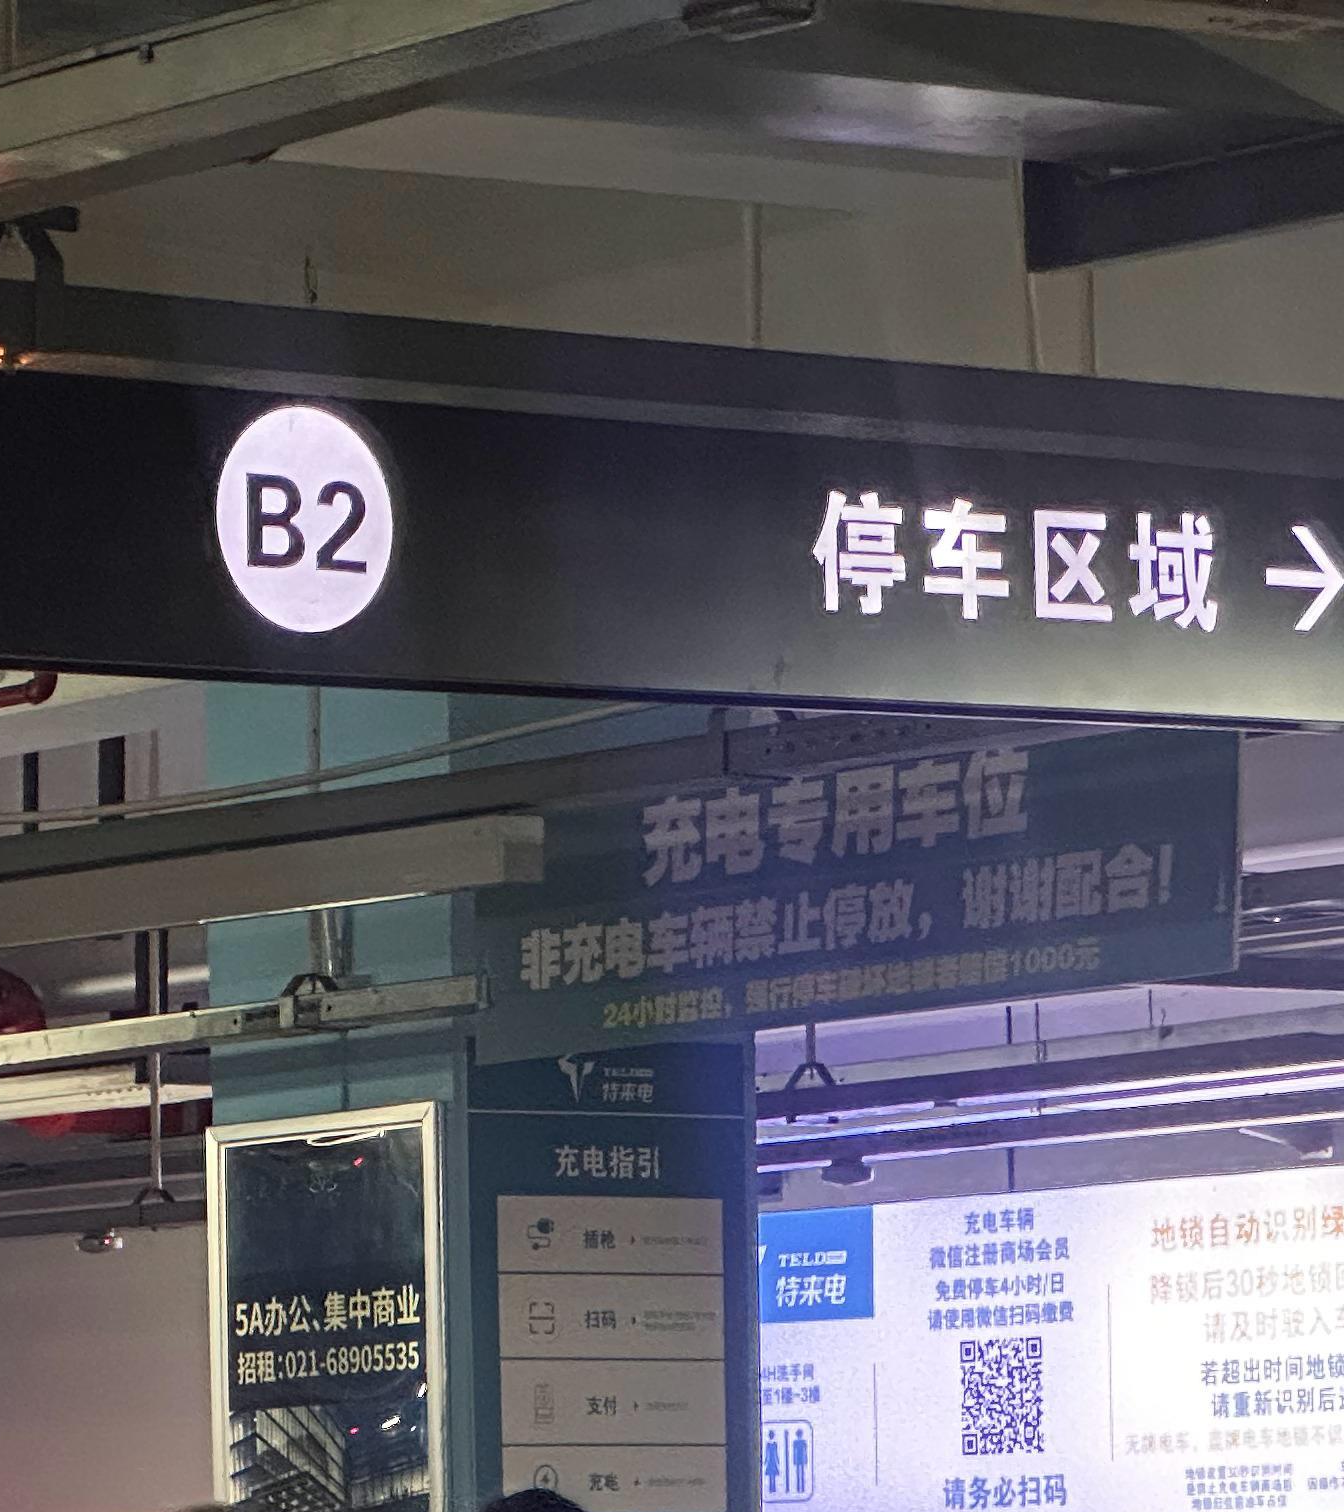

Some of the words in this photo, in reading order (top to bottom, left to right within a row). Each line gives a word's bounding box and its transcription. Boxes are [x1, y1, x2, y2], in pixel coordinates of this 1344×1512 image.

[244, 473, 370, 575] B2
[812, 490, 1219, 634] 停车区域
[642, 748, 1029, 889] 充电专用车位
[602, 1082, 654, 1104] 特来电
[555, 1145, 661, 1181] 充电指引
[965, 1208, 1034, 1235] 充电车辆
[930, 1237, 1070, 1269] 微信注册商场会员
[776, 1273, 847, 1307] 特来电
[235, 1283, 421, 1337] 5A办公、集中商业
[584, 1309, 616, 1330] 扫码
[928, 1301, 1073, 1331] 请使用微信扫码缴费
[237, 1341, 420, 1385] 招租:021-68905535
[585, 1395, 617, 1416] 支付
[1211, 1387, 1344, 1418] 请重新识别后
[944, 1473, 1067, 1510] 请务必扫码
